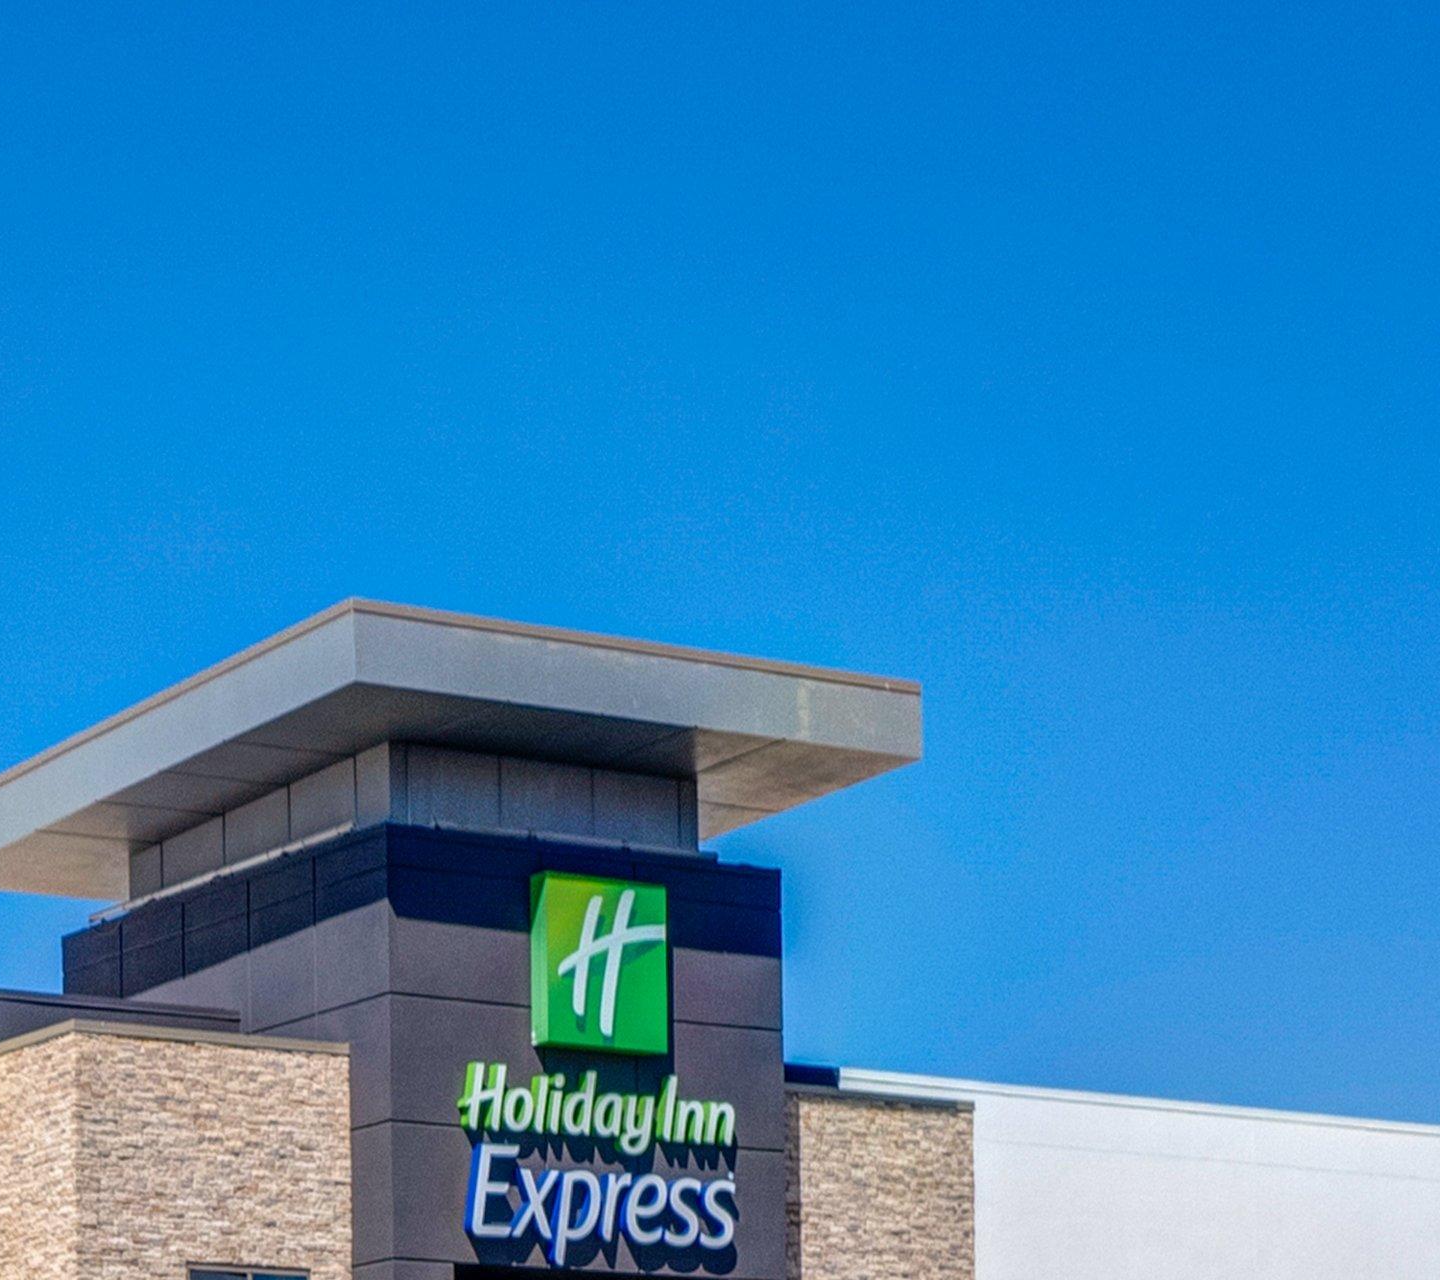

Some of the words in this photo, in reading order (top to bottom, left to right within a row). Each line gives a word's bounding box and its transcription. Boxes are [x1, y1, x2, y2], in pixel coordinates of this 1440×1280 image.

[458, 1061, 654, 1154] Holiday
[656, 1074, 735, 1146] Inn
[465, 1142, 735, 1266] Express
